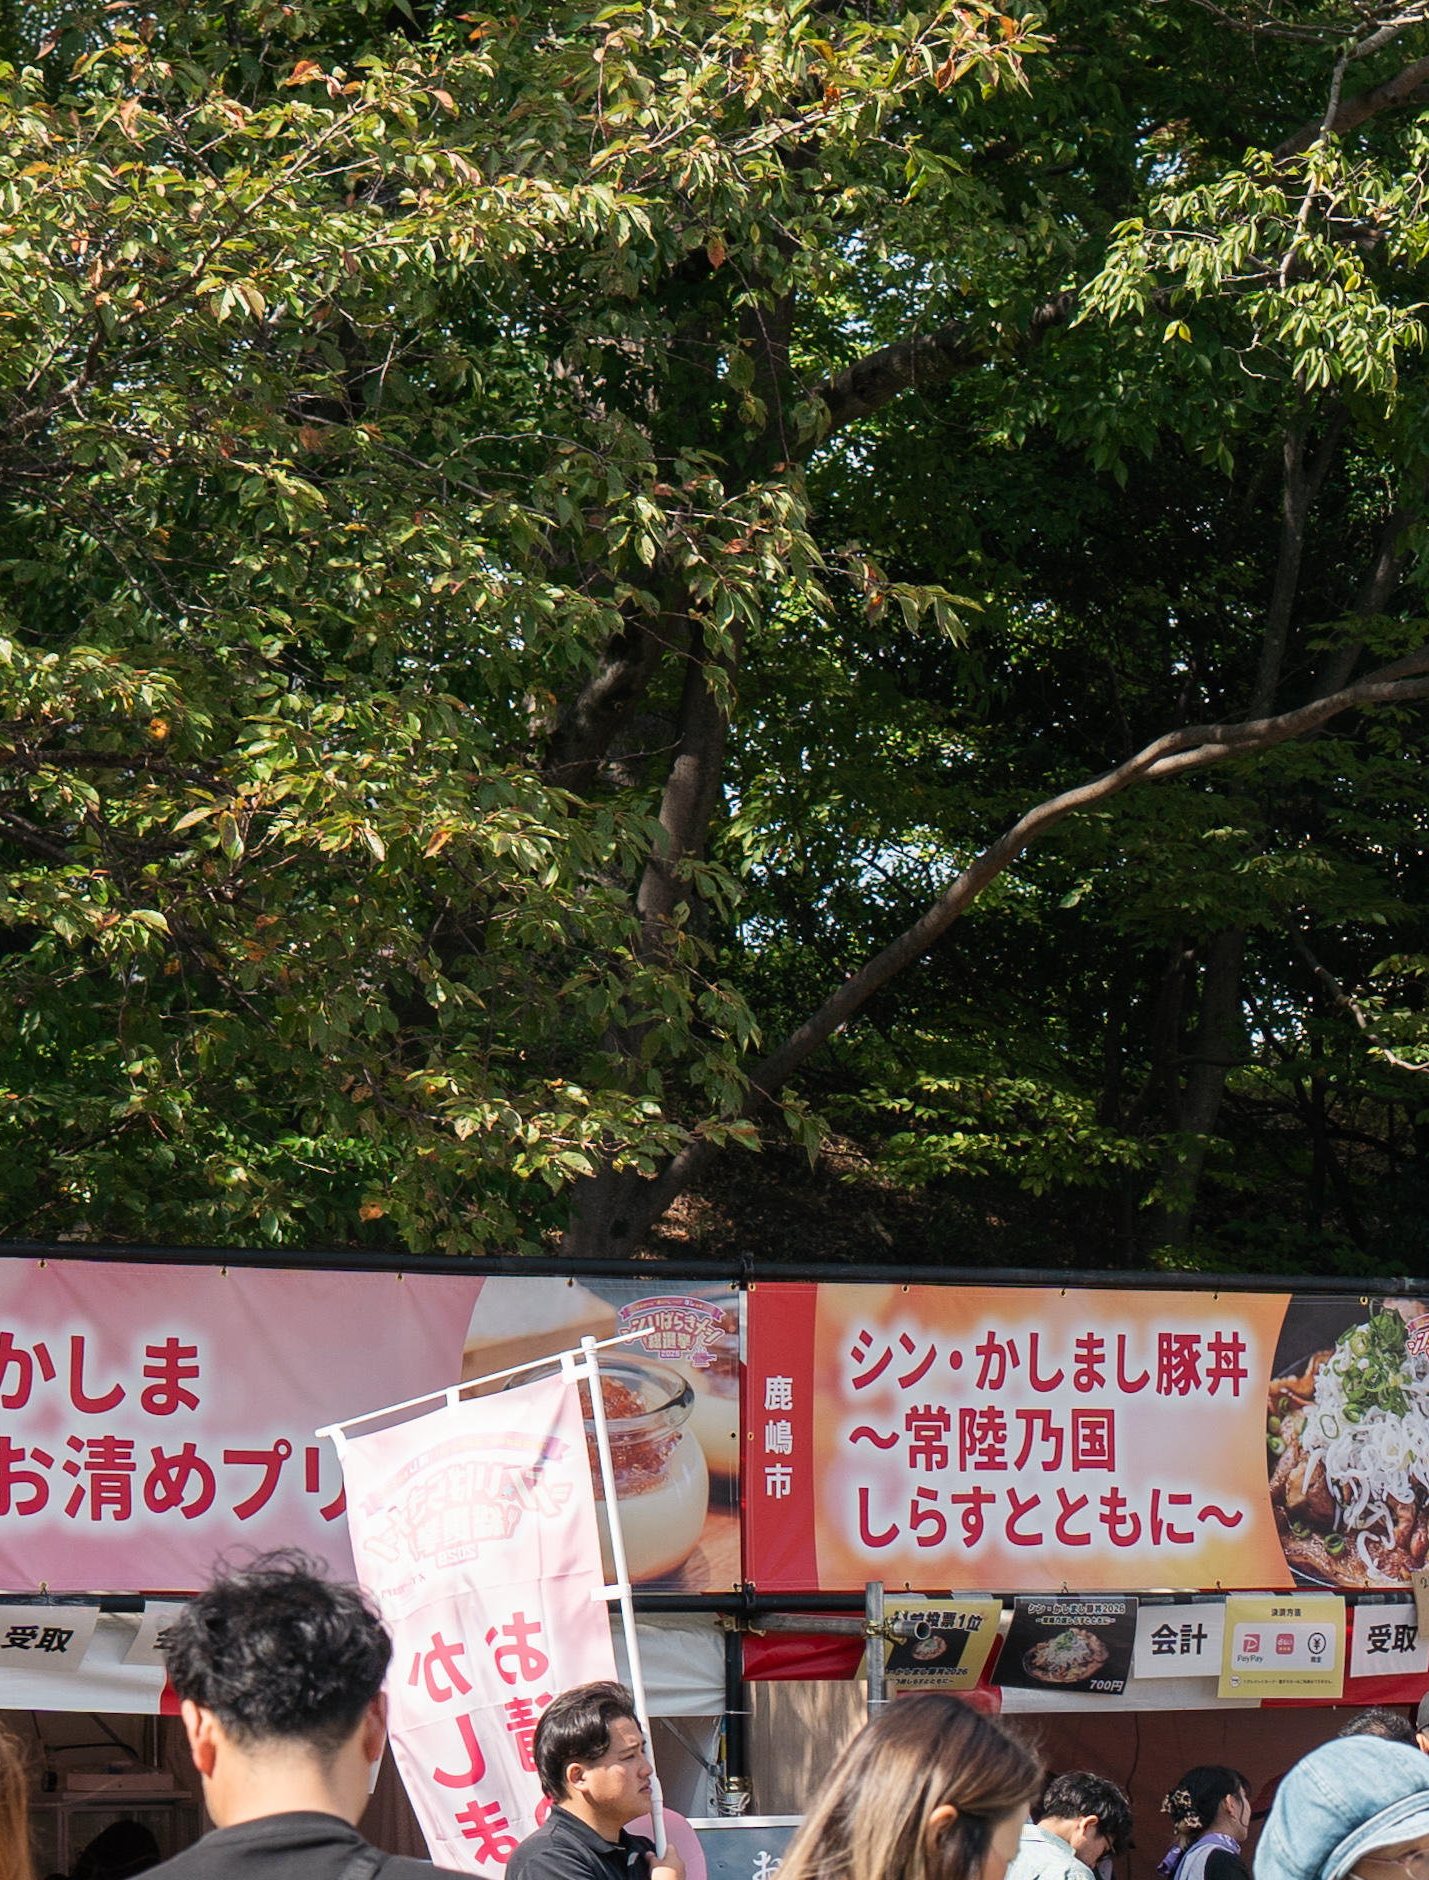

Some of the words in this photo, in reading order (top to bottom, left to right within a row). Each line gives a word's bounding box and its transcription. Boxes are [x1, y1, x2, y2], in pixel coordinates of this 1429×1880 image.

[850, 1329, 1249, 1399] シン・かしまし豚丼
[764, 1376, 793, 1499] 鹿嶋市
[856, 1485, 1244, 1549] しらすとともに～
[0, 1625, 73, 1653] 受取
[1151, 1623, 1208, 1657] 会計
[1366, 1624, 1418, 1655] 受取
[1237, 1655, 1263, 1663] PayPay
[1089, 1680, 1124, 1692] 700円
